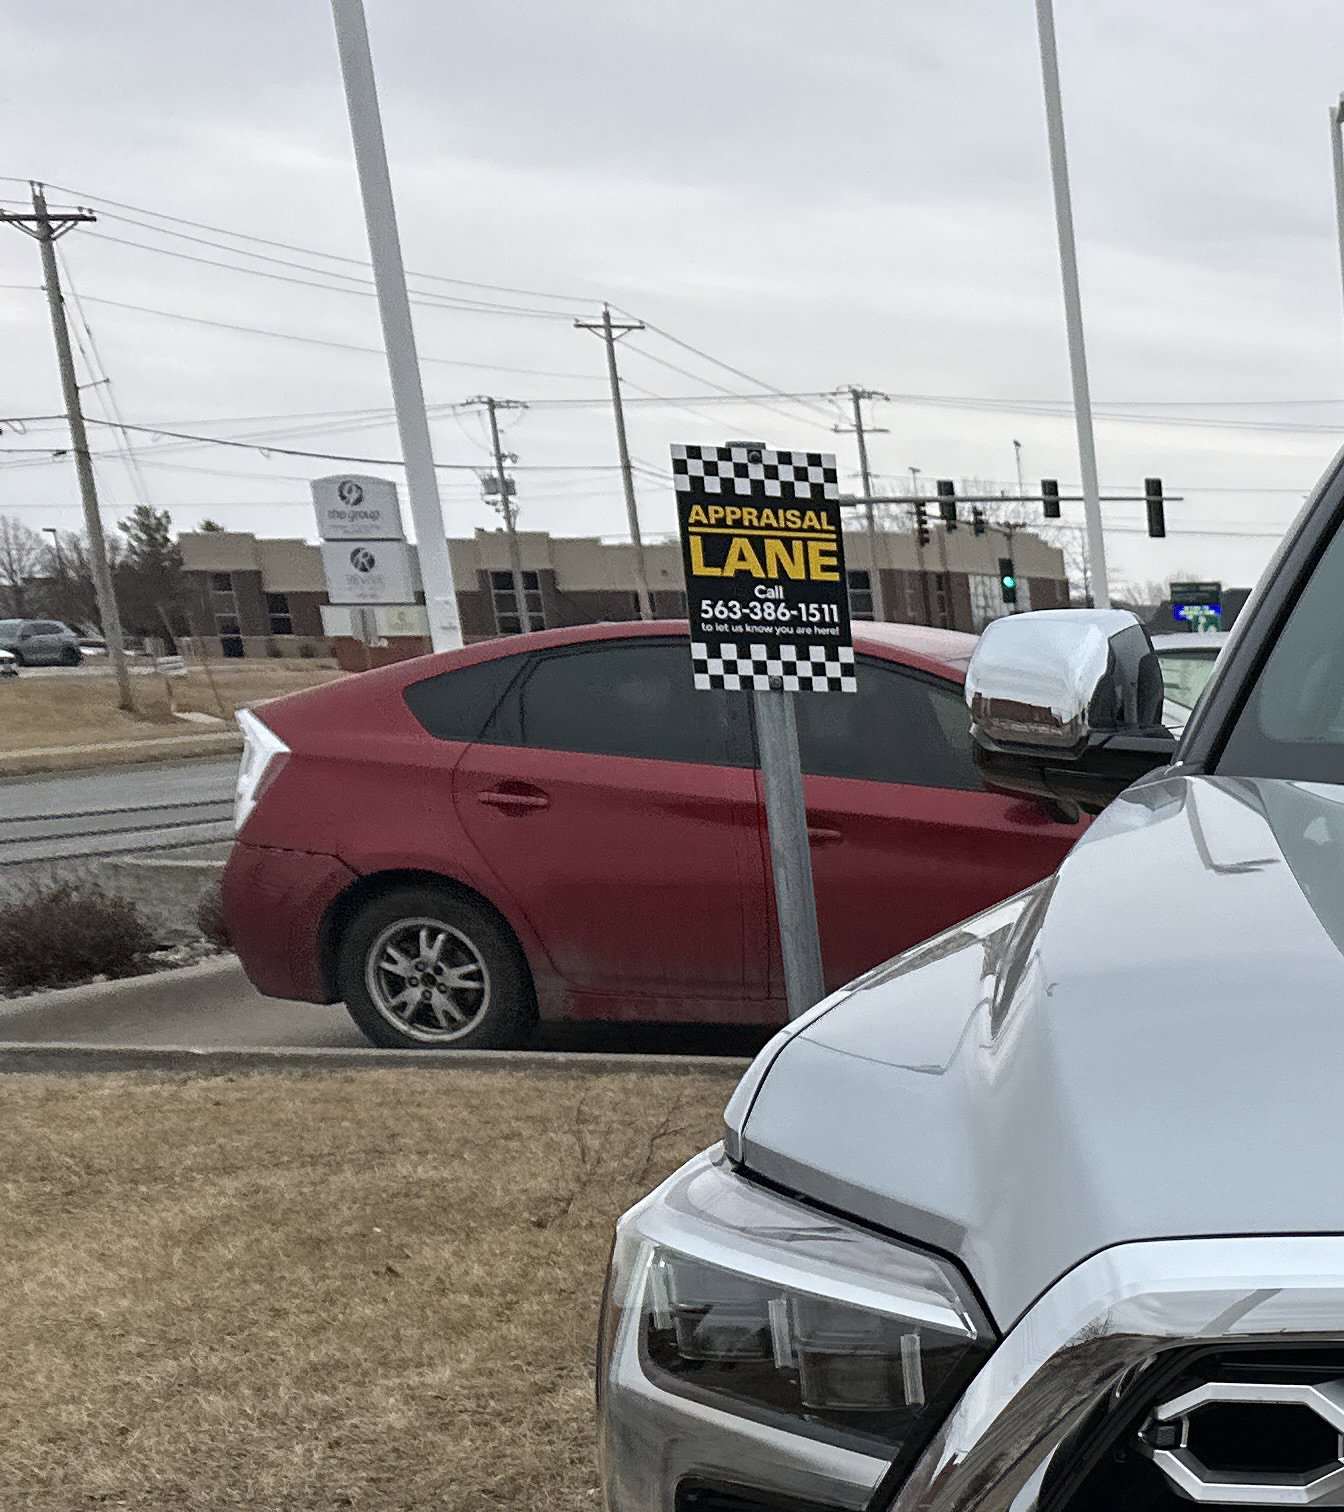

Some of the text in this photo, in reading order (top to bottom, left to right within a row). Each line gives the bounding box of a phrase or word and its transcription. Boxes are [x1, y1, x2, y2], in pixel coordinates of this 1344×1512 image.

[689, 504, 836, 531] APPRAISAL
[689, 534, 841, 582] LANE
[753, 584, 784, 600] Call
[700, 599, 840, 623] 563-386-1511
[701, 622, 713, 632] to
[715, 622, 729, 633] let
[731, 624, 743, 633] us
[745, 623, 773, 634] know
[774, 625, 794, 636] you
[795, 626, 813, 635] are
